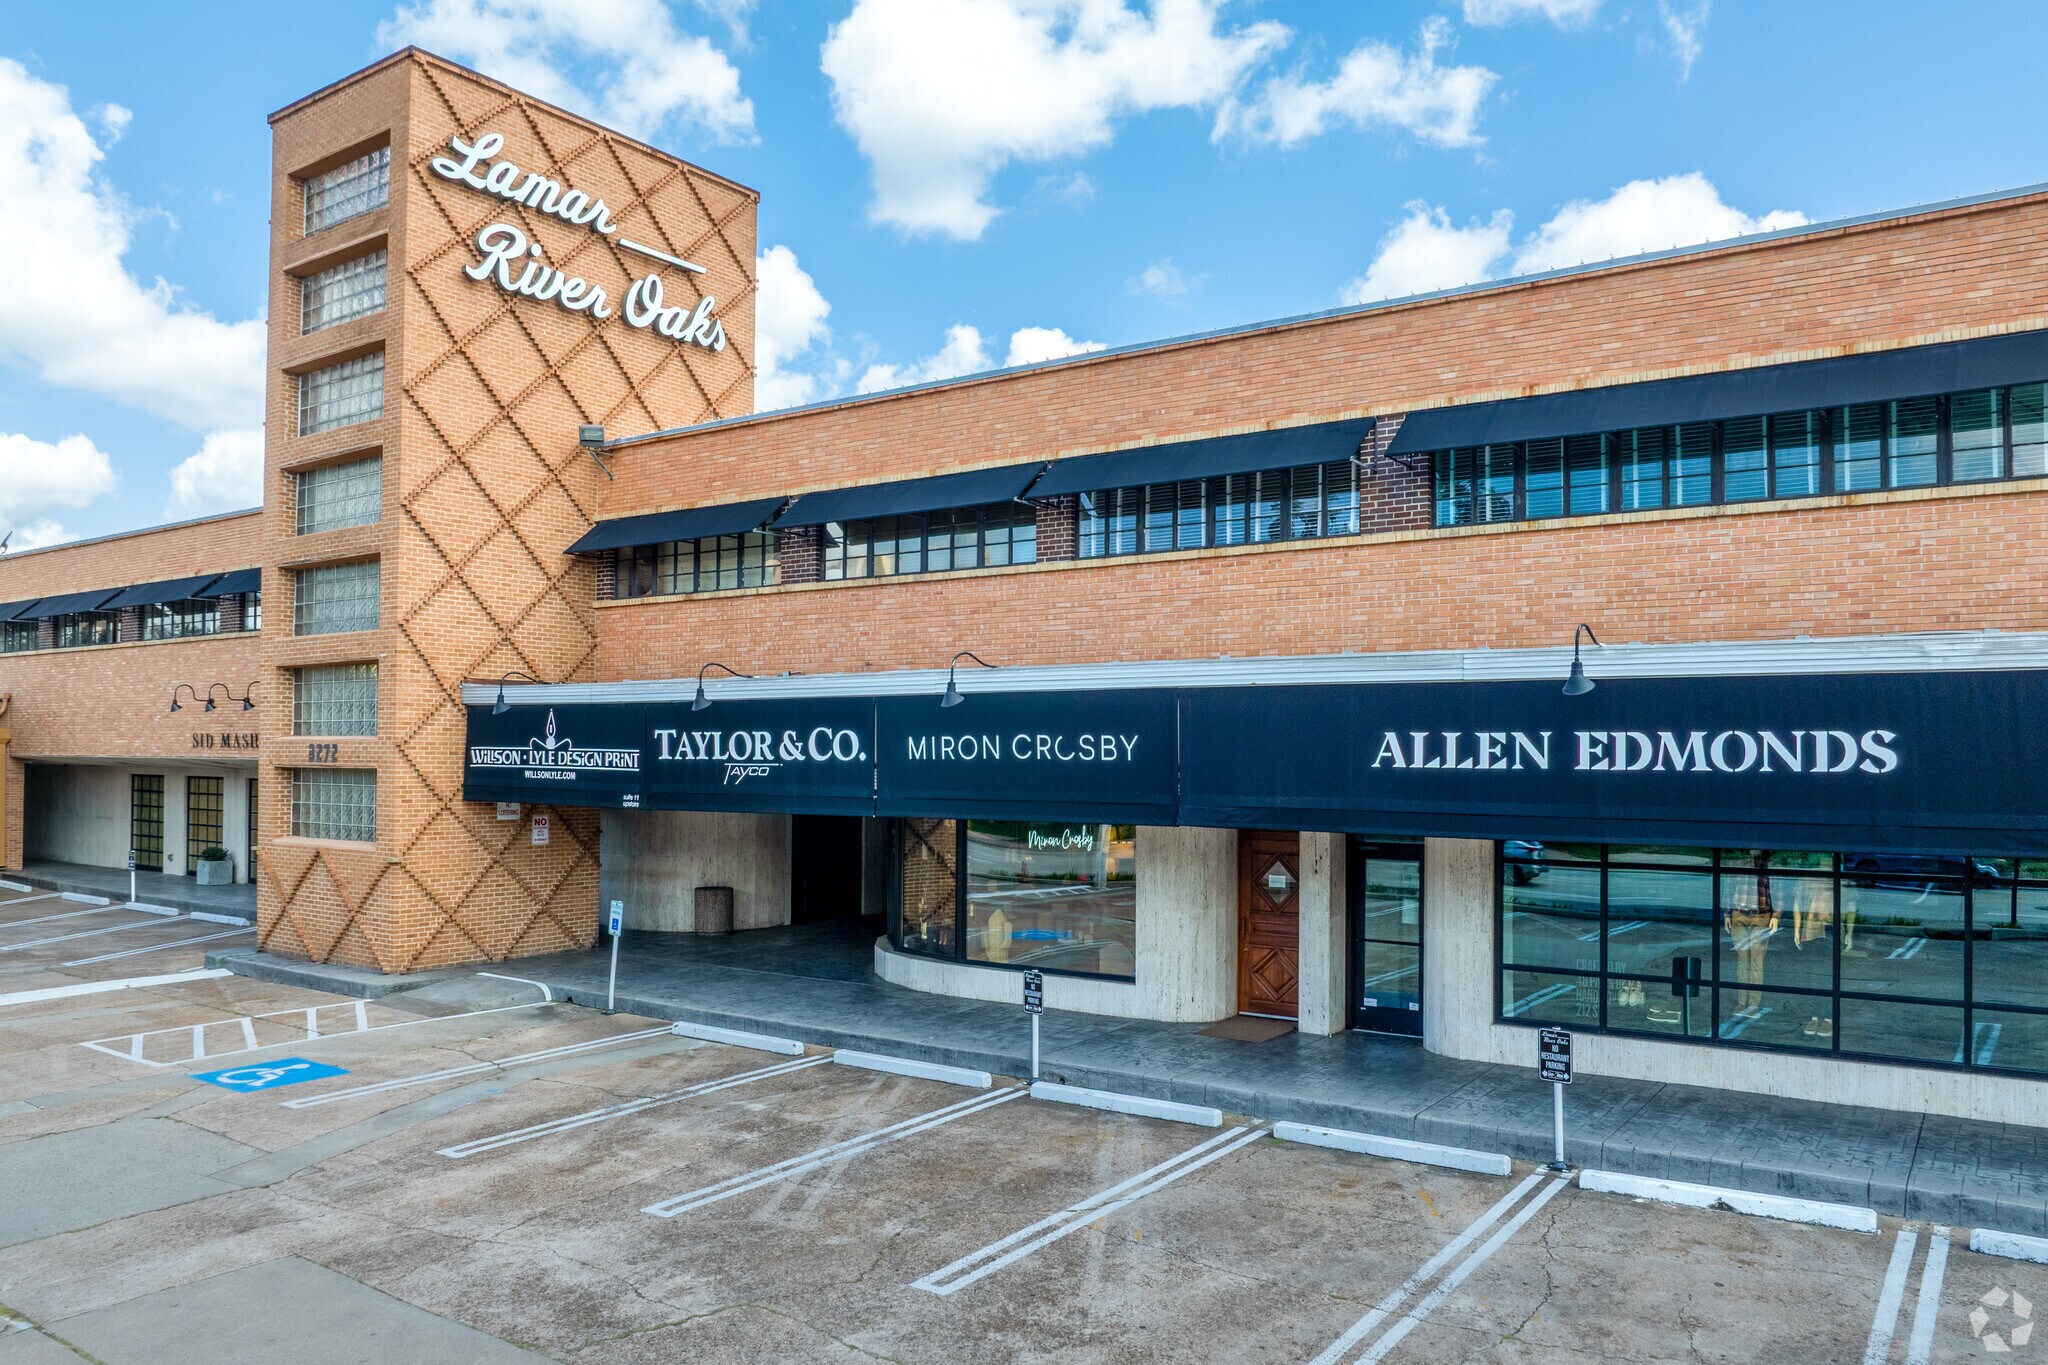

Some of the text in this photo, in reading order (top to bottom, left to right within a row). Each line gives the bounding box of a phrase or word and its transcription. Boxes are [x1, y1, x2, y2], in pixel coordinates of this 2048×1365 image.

[429, 132, 617, 234] Lamar
[462, 223, 726, 352] River Oaks
[192, 732, 214, 748] SID
[654, 727, 867, 762] TAYLOR & CO.
[908, 735, 1000, 760] MIRON
[308, 743, 339, 763] 3272
[528, 750, 555, 766] LYLE
[1371, 730, 1900, 774] ALLEN EDMONDS
[524, 770, 576, 780] WILLSONLYLE.COM
[534, 817, 547, 826] NO
[1028, 824, 1094, 852] Miron Crosby
[1576, 1002, 1591, 1017] 212
[1551, 1044, 1559, 1052] NO
[1541, 1052, 1570, 1063] RESTAURANT
[1545, 1061, 1566, 1071] PARKING
